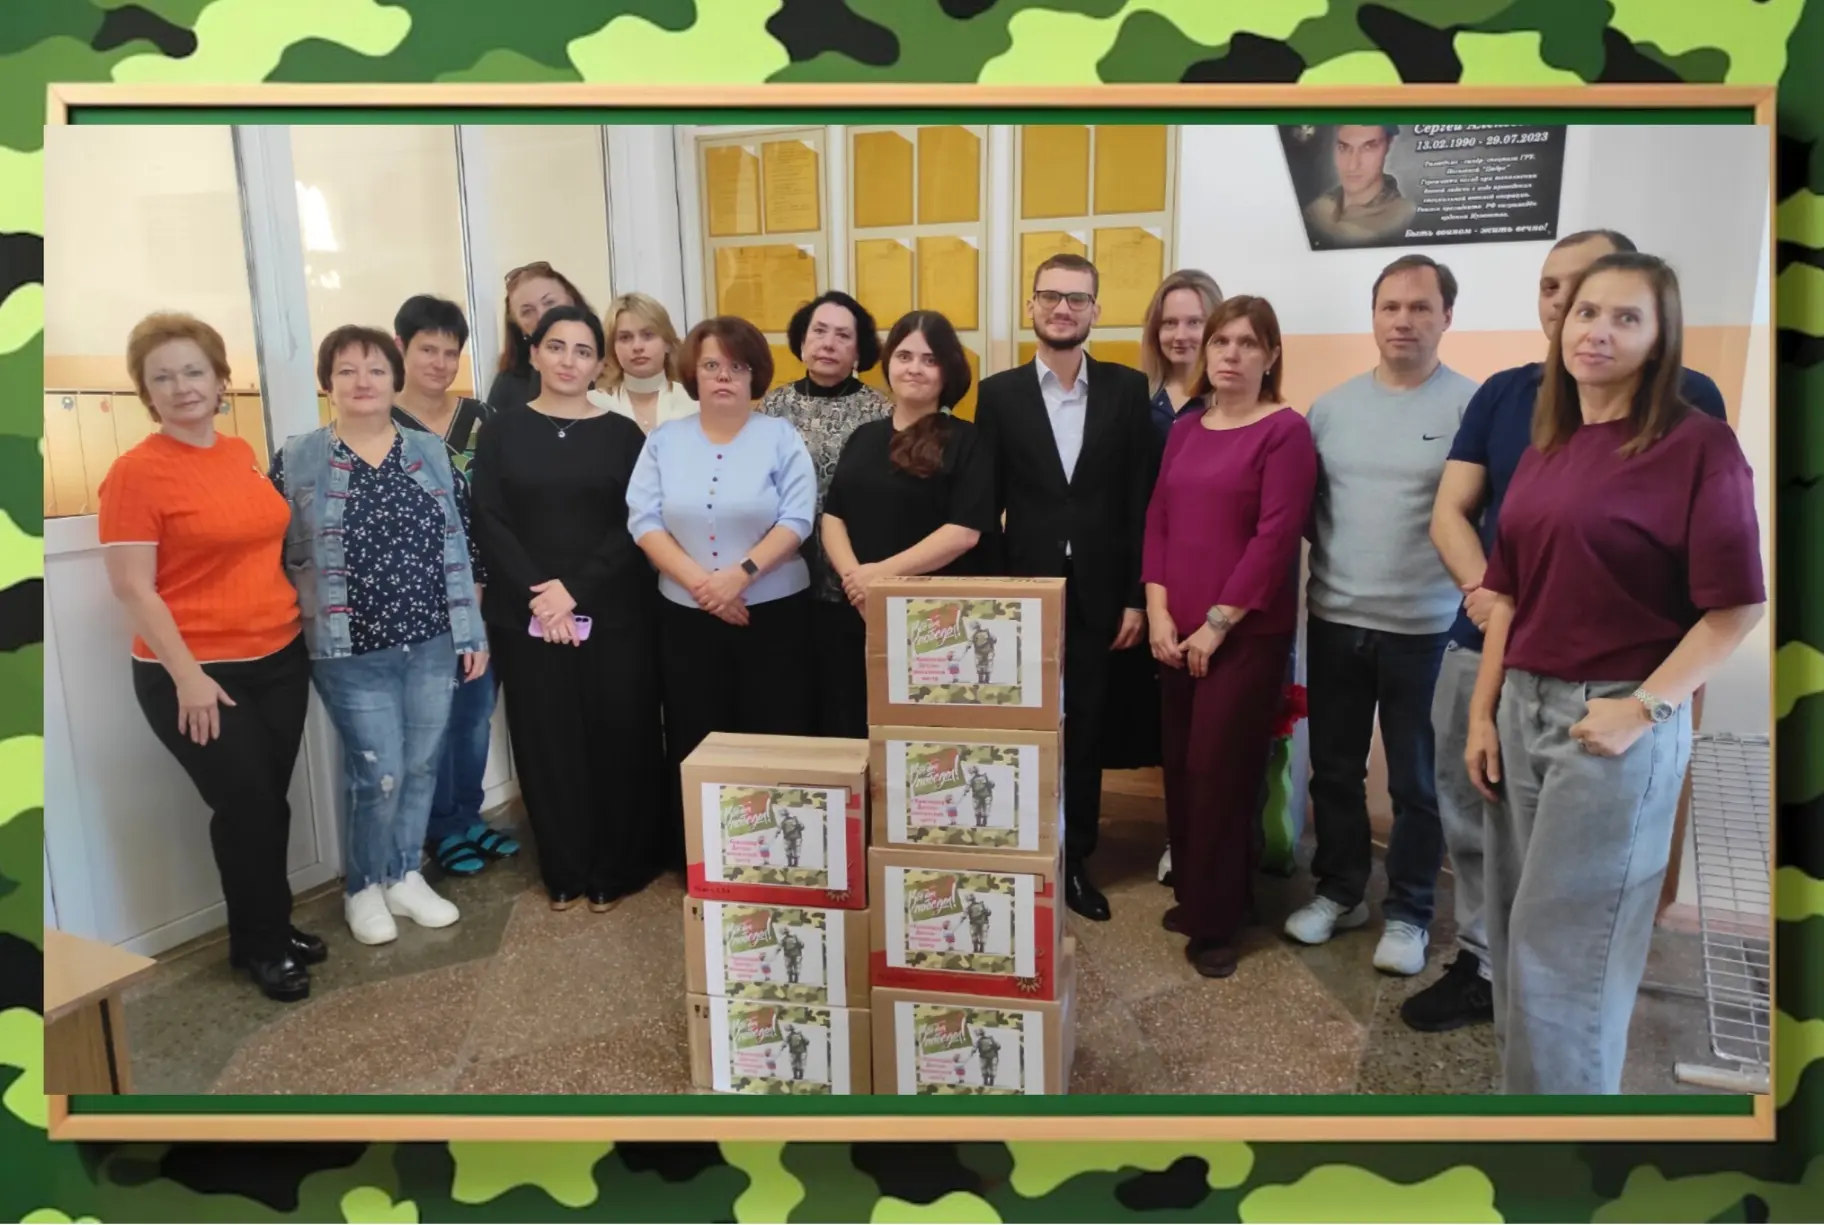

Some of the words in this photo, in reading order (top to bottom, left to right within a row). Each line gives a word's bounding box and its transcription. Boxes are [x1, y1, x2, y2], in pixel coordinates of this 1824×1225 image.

[1416, 137, 1477, 151] 13.02.1990
[1485, 131, 1549, 146] 29.07.2023
[1515, 221, 1549, 233] вечно!
